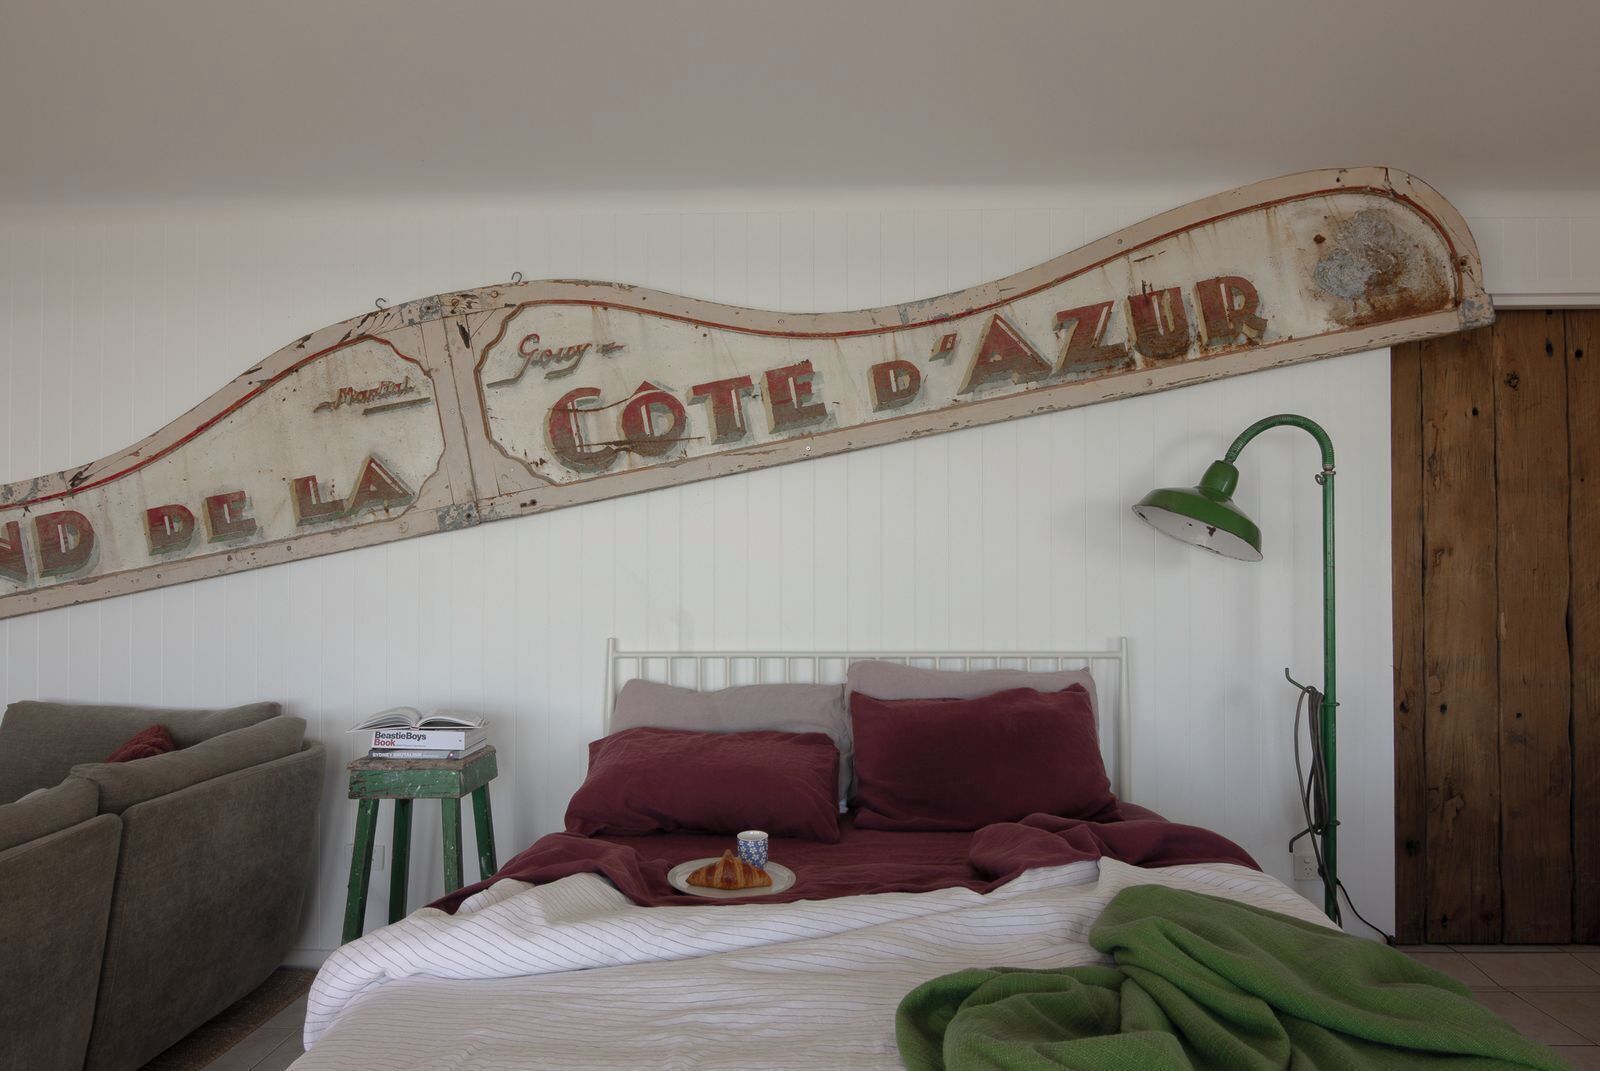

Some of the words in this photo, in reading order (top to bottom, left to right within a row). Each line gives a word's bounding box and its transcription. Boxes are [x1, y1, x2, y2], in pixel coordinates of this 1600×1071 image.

[144, 490, 257, 555] DE
[291, 456, 416, 526] LA
[866, 275, 1269, 413] D'AZUR
[373, 739, 396, 747] Book
